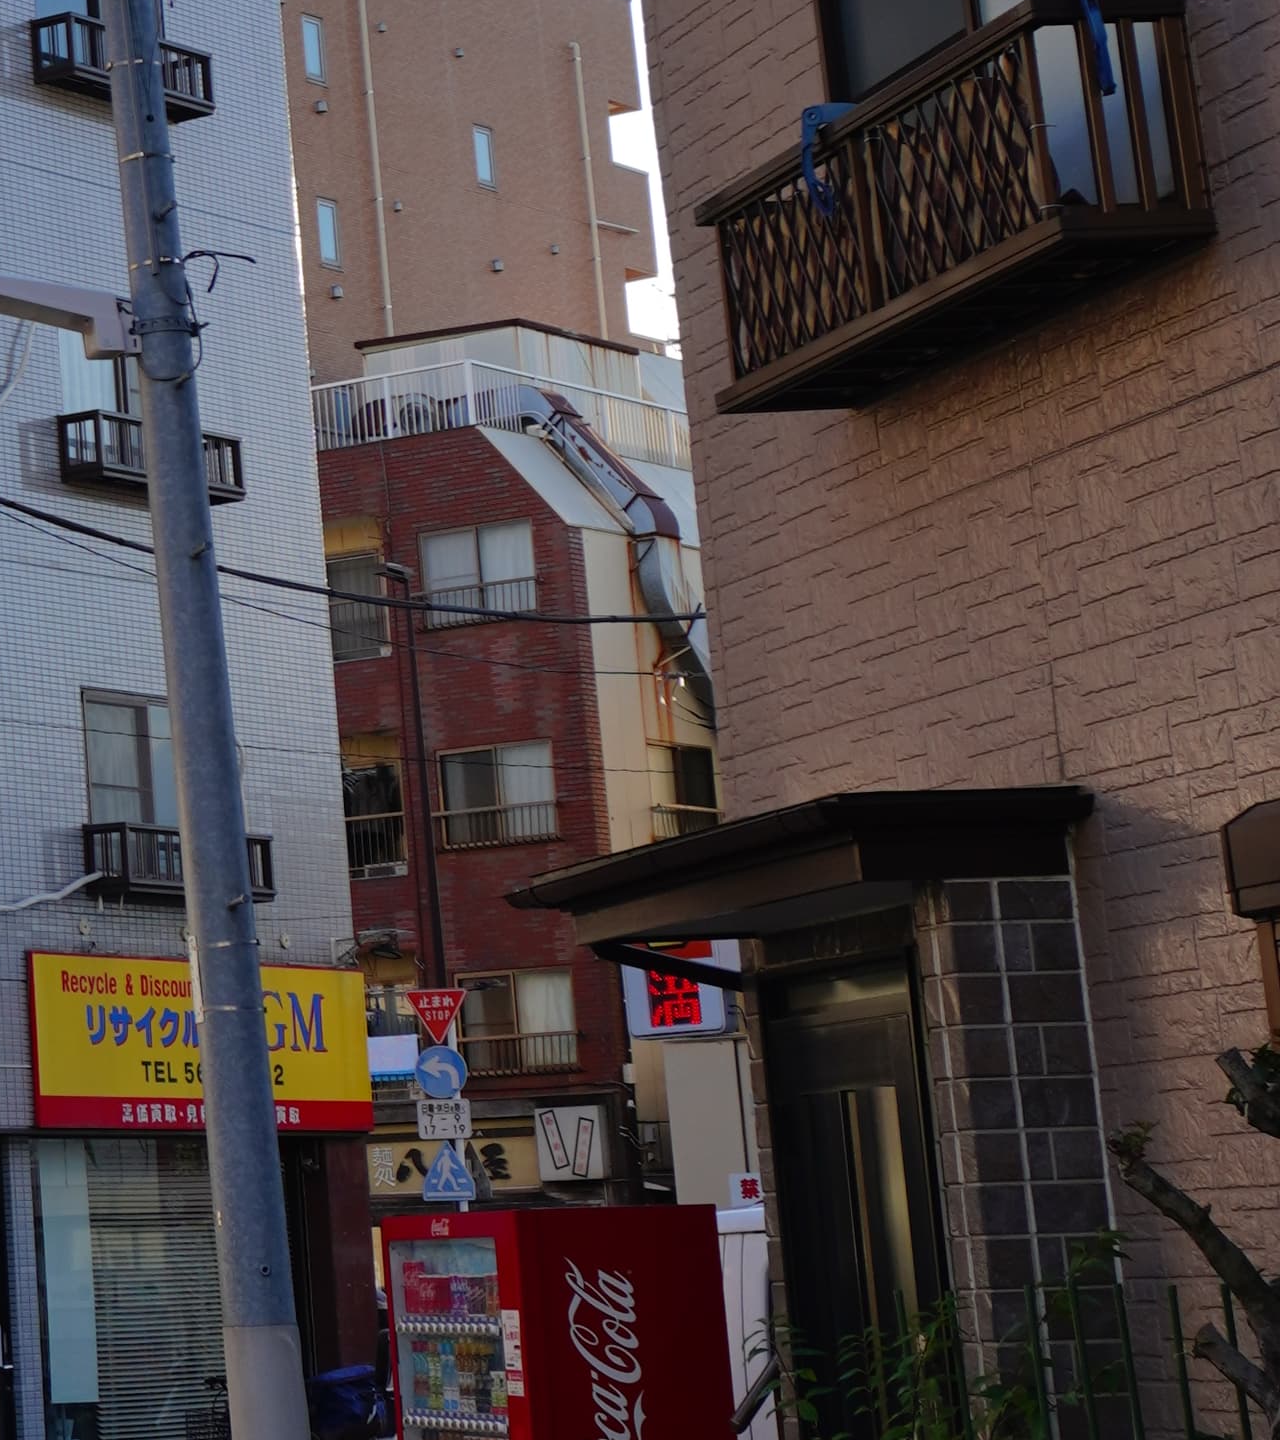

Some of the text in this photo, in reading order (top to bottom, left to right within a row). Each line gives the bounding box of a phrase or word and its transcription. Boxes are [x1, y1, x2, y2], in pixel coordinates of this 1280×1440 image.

[61, 970, 117, 994] Recycle
[125, 973, 133, 995] &
[419, 995, 454, 1008] 止まれ
[86, 1004, 199, 1048] リサイクル
[425, 1010, 451, 1021] STOP
[141, 1061, 177, 1083] TEL
[740, 1178, 760, 1200] 禁
